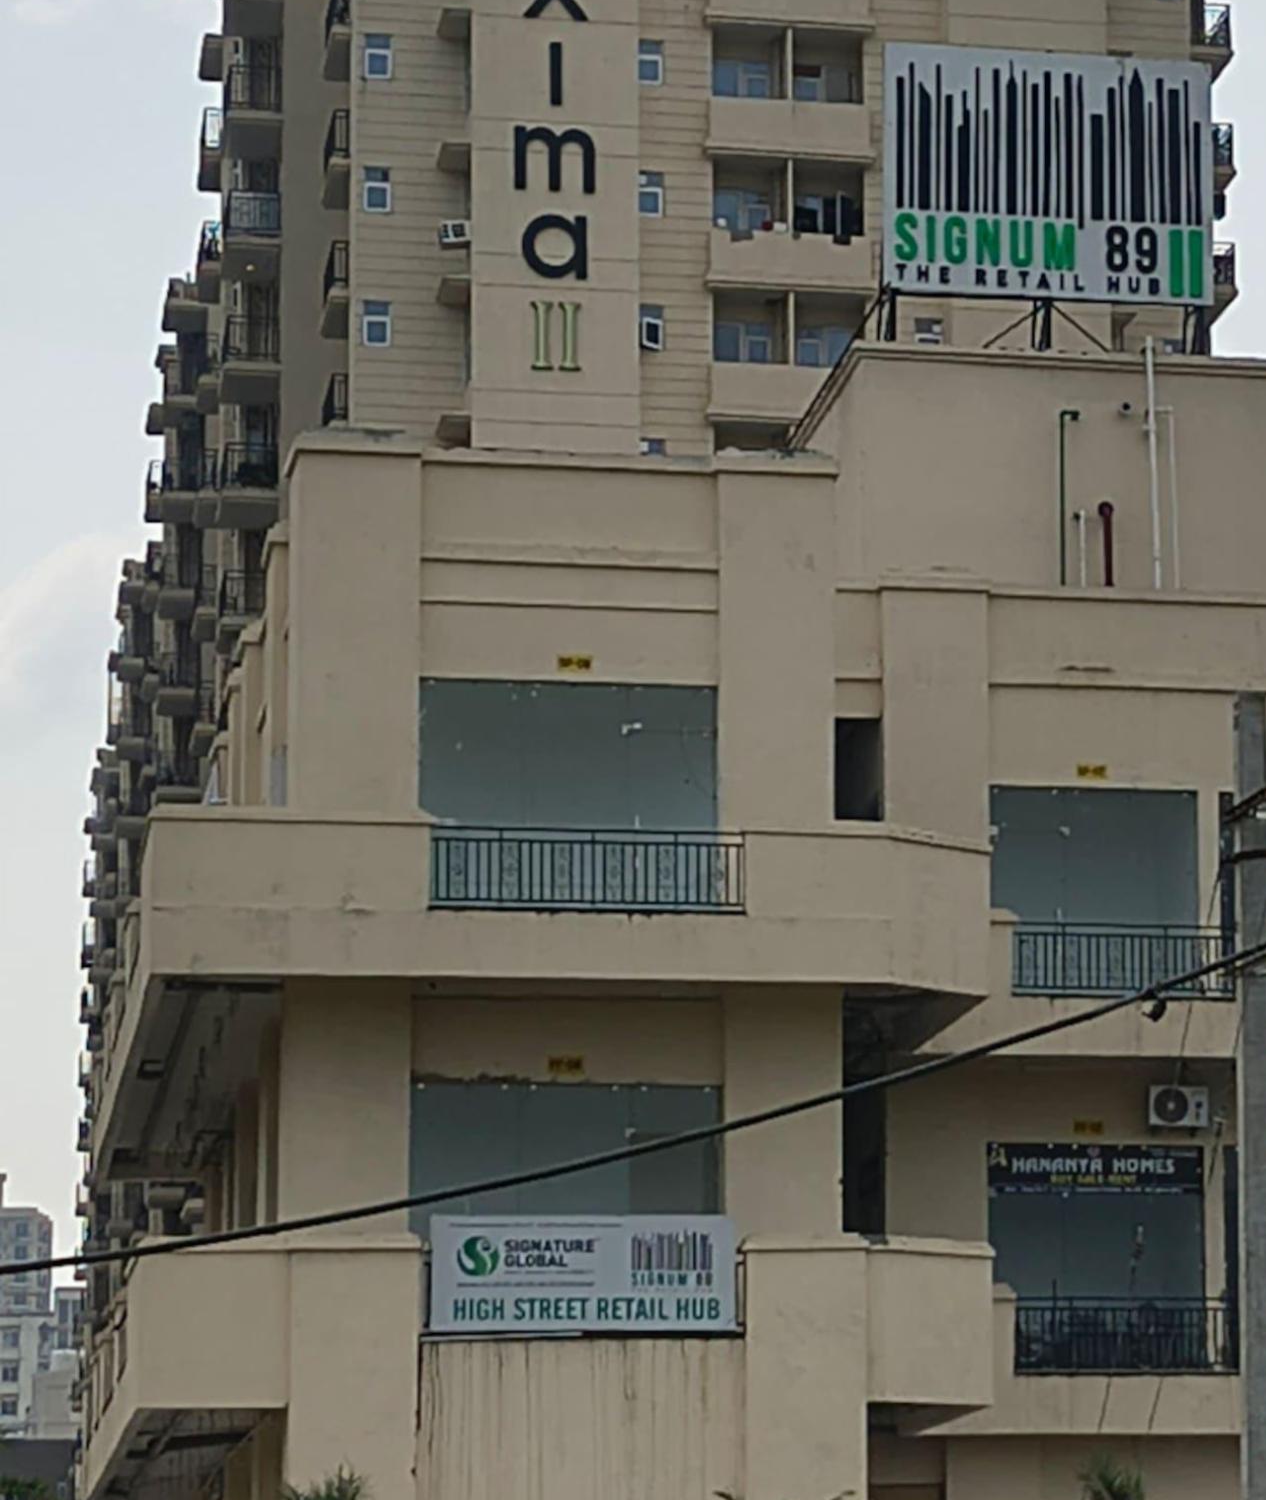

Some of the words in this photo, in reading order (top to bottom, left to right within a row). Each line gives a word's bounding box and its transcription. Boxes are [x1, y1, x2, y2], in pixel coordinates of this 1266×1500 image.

[894, 212, 1076, 272] SIGNUM
[1105, 225, 1159, 274] 89
[895, 263, 952, 285] THE
[974, 269, 1085, 292] RETAIL
[1106, 275, 1161, 296] HUB
[1112, 1157, 1176, 1175] HOMES
[503, 1238, 596, 1254] SIGNATURE
[503, 1253, 569, 1268] GLOBAL
[453, 1297, 506, 1322] HIGH
[513, 1297, 591, 1321] STREET
[597, 1296, 670, 1321] RETAIL
[676, 1297, 721, 1321] HUB
